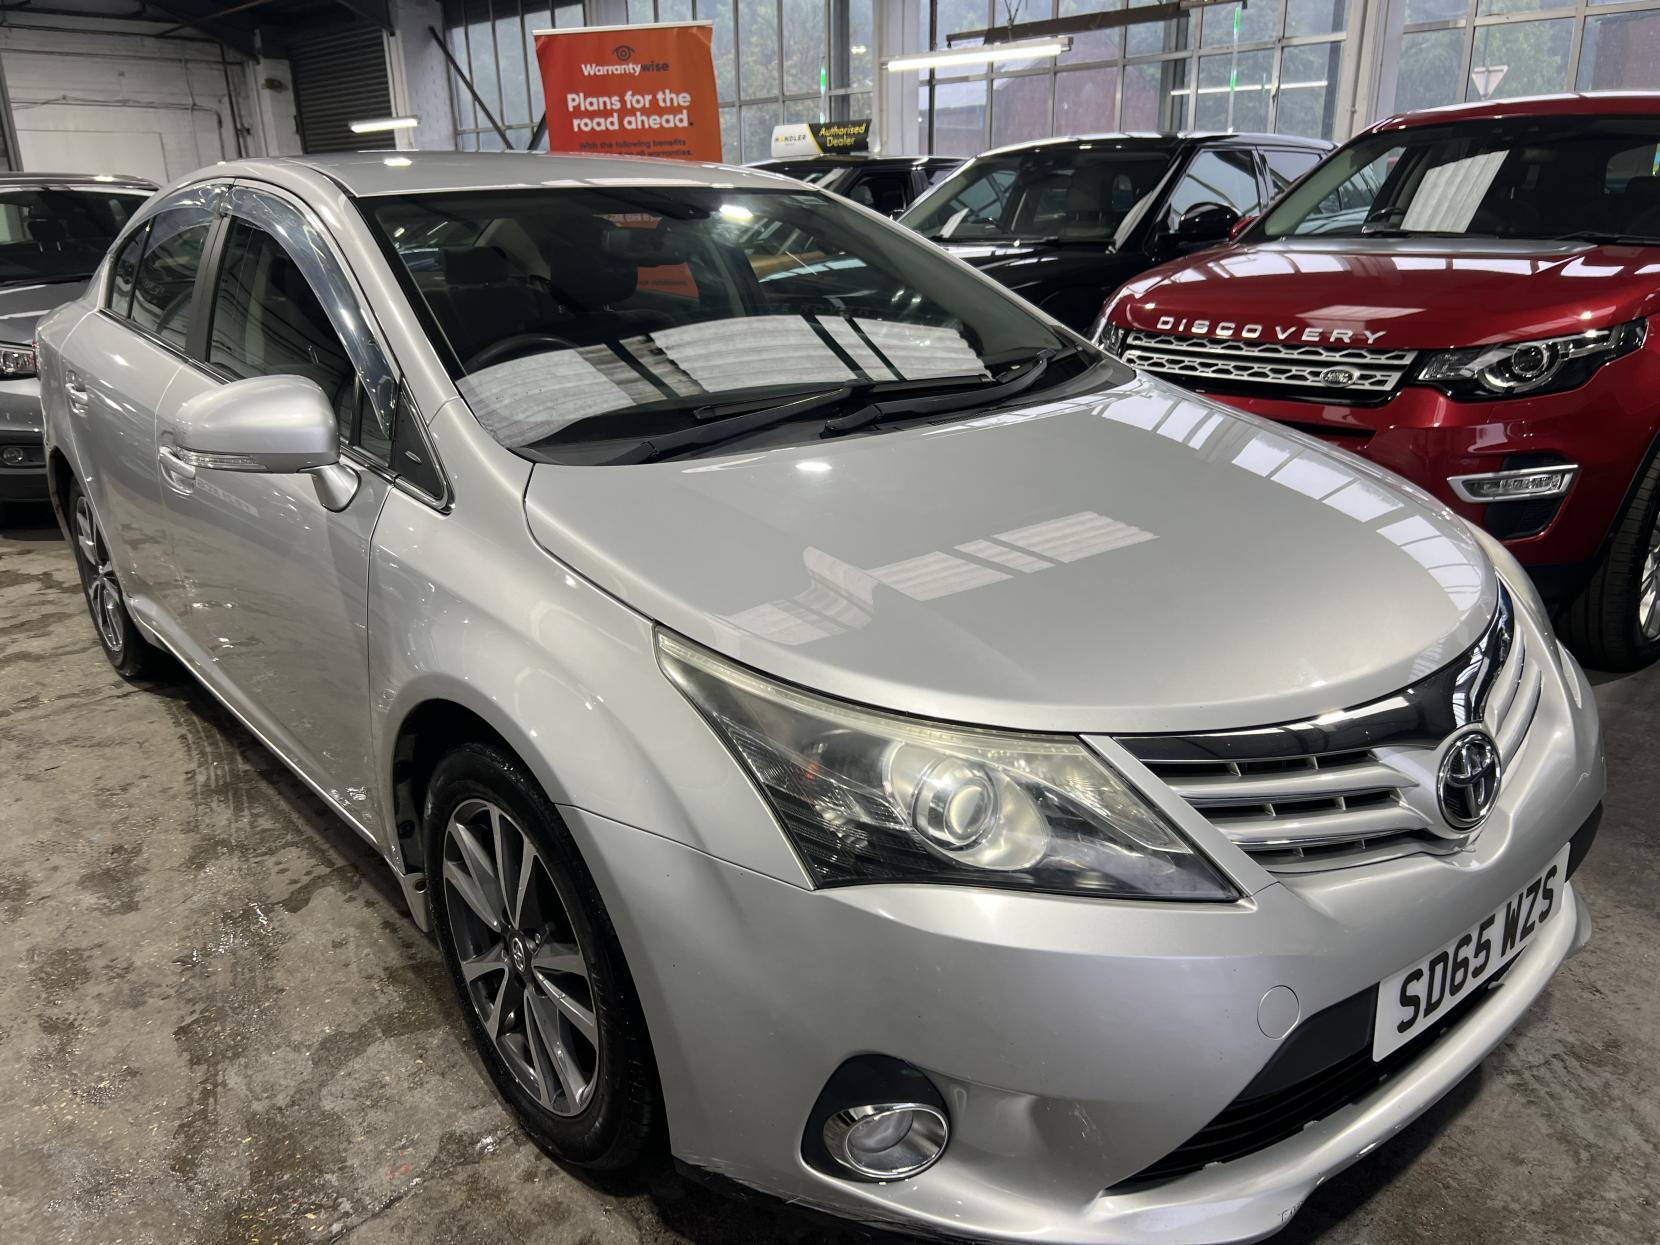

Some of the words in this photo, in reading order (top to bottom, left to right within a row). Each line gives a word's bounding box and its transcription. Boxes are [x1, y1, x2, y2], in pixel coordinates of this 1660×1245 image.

[582, 61, 669, 76] Warrantywise
[566, 92, 621, 111] Plans
[625, 90, 653, 109] for
[656, 89, 691, 107] the
[572, 112, 619, 131] road
[623, 110, 694, 129] ahead.
[819, 123, 866, 136] Authorised
[826, 136, 856, 147] Dealer
[1156, 316, 1387, 344] DISCOVERY
[1396, 913, 1496, 1034] SD65
[1500, 864, 1558, 958] WZS
